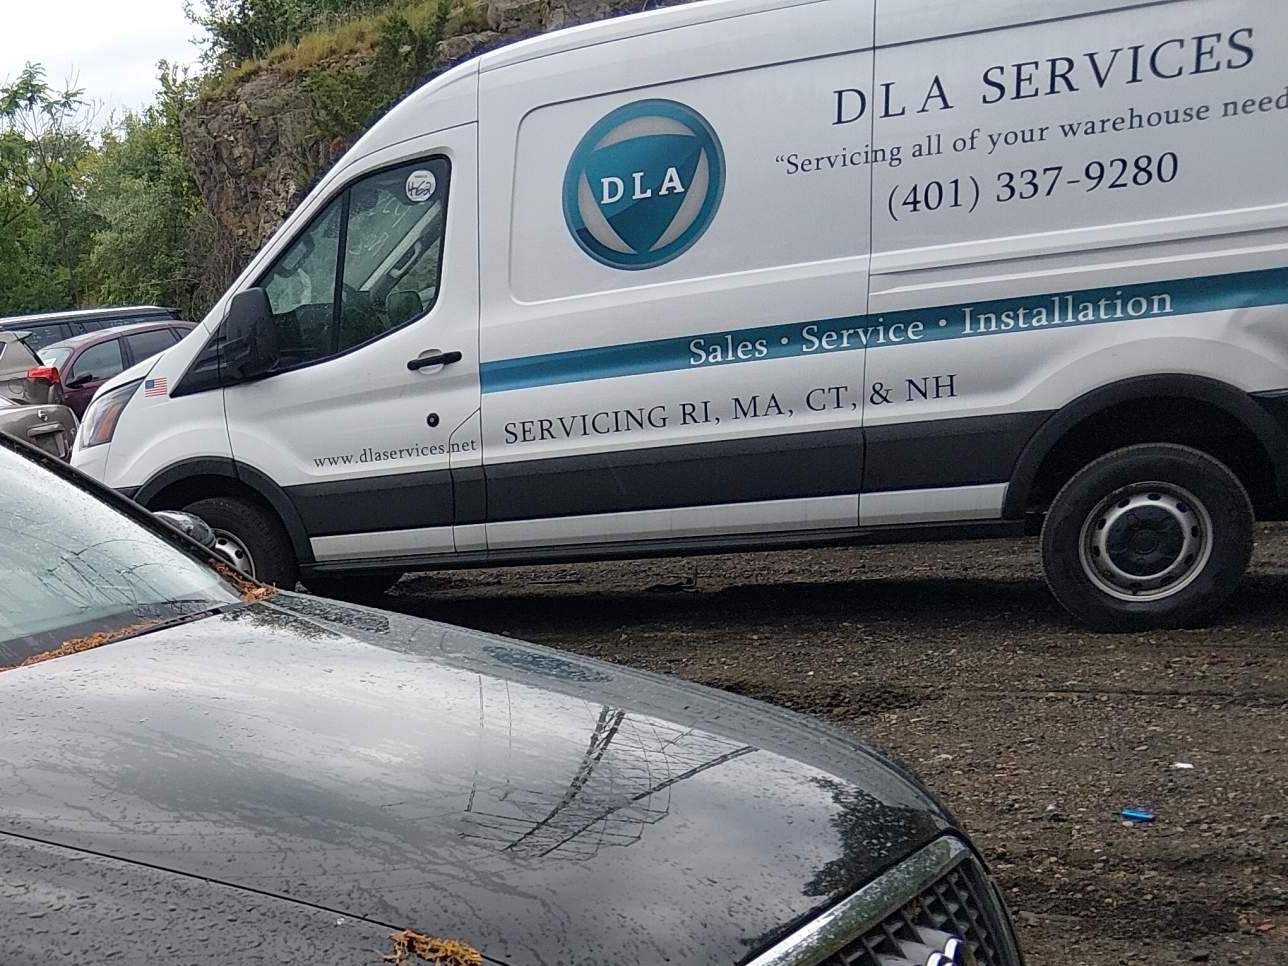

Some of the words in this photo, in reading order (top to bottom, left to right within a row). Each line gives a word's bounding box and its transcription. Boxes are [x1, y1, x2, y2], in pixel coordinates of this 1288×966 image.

[832, 75, 954, 125] DLA
[982, 27, 1254, 104] SERVICES
[775, 143, 903, 175] “Servicing
[912, 134, 943, 158] all
[952, 128, 981, 153] of
[987, 124, 1049, 155] your
[1060, 103, 1210, 139] warehouse
[600, 166, 686, 205] DLA
[888, 175, 980, 222] (401)
[996, 151, 1179, 202] 337-9280
[689, 335, 768, 365] Sales
[801, 317, 925, 353] Service
[961, 289, 1175, 334] Installation
[504, 405, 668, 445] SERVICING
[680, 400, 720, 426] RI,
[731, 393, 794, 420] MA,
[806, 386, 857, 412] CT,
[869, 382, 894, 405] &
[905, 374, 958, 402] NH
[313, 439, 477, 468] www.dlaservices.net
